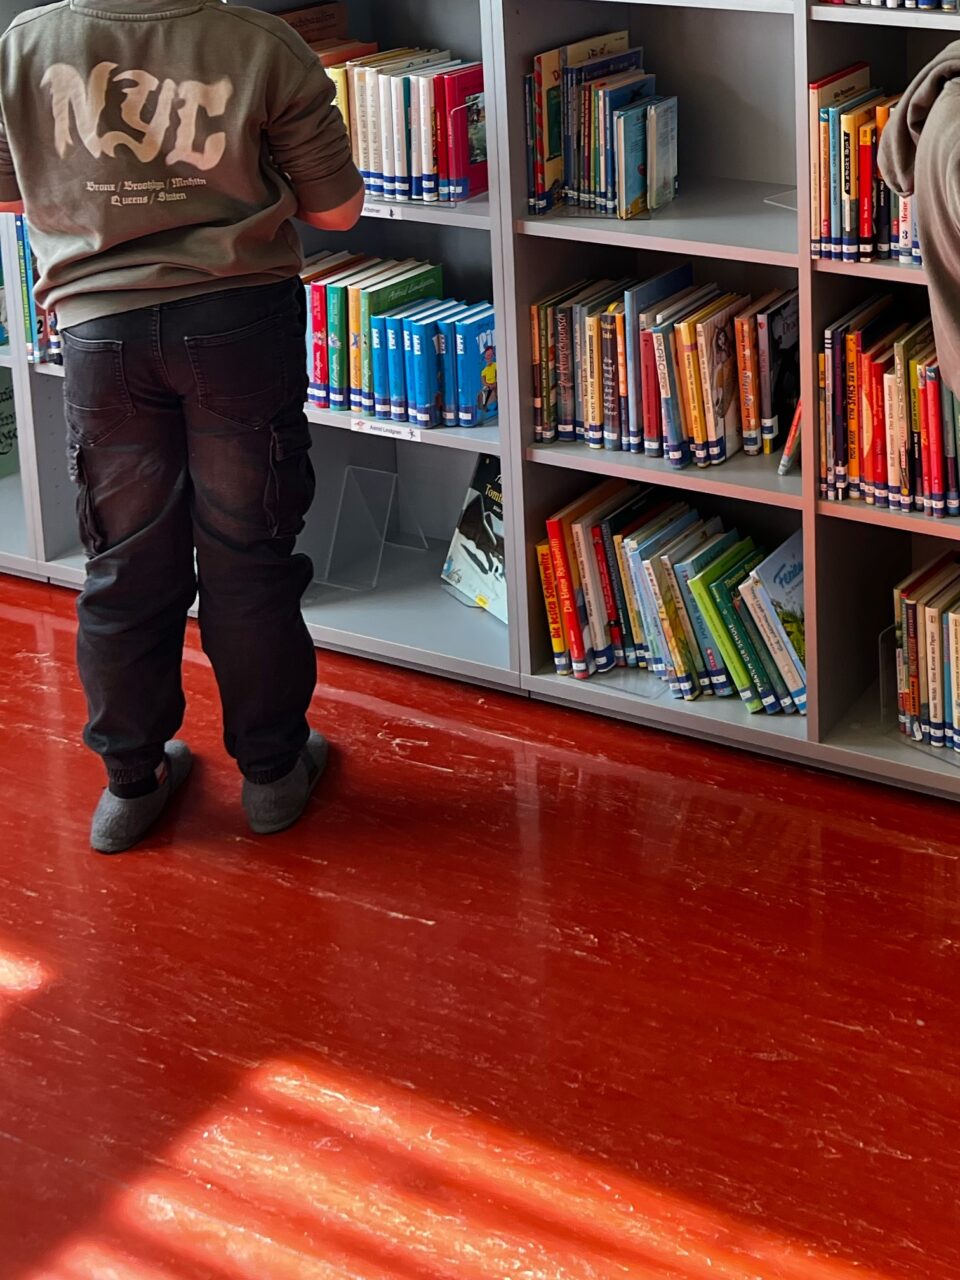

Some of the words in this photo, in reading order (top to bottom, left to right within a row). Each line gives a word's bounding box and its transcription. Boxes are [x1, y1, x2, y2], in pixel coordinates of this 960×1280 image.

[40, 61, 234, 171] NYC
[86, 181, 115, 192] Bronx
[111, 195, 148, 207] Queens
[157, 192, 186, 202] Staten
[540, 552, 556, 599] Schülerwitze
[548, 601, 559, 624] besten
[563, 600, 573, 612] Die
[551, 627, 561, 639] Die
[728, 624, 741, 648] SCHULE
